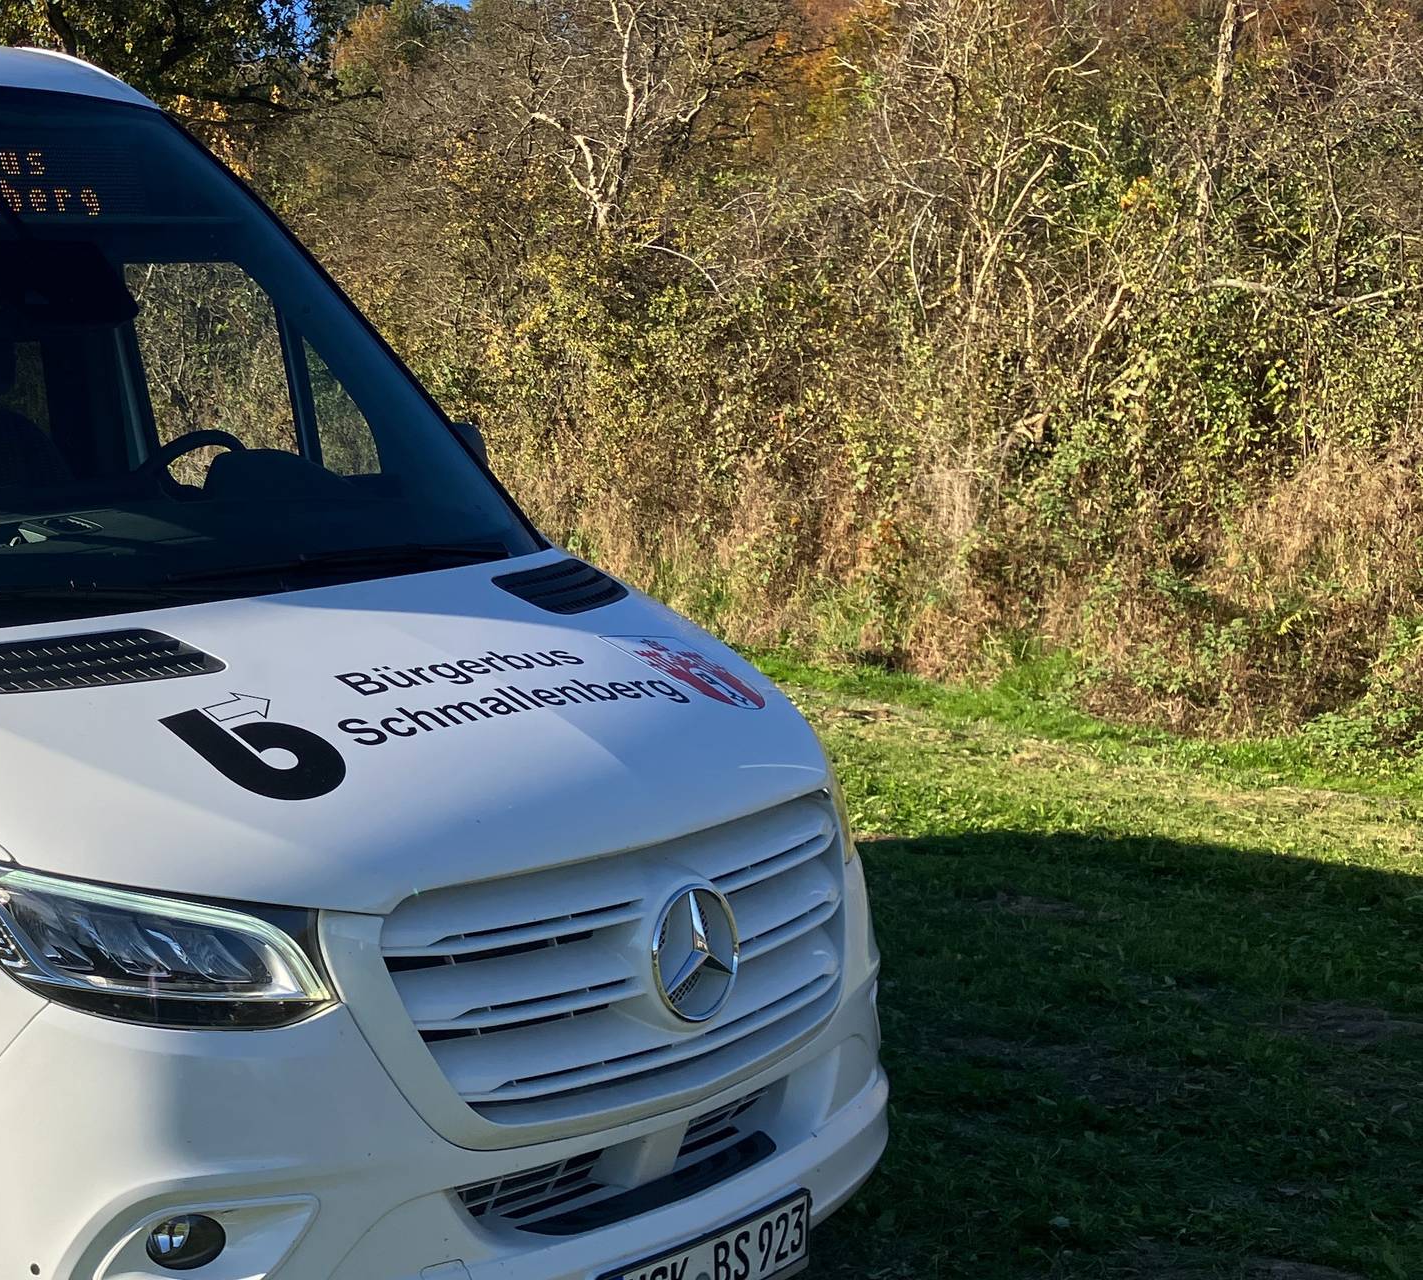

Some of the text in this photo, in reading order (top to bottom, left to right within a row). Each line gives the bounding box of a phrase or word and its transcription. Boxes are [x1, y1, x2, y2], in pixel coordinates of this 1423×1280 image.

[334, 650, 584, 696] Bürgerbus
[337, 679, 691, 746] Schmallenberg
[758, 1202, 805, 1272] 923
